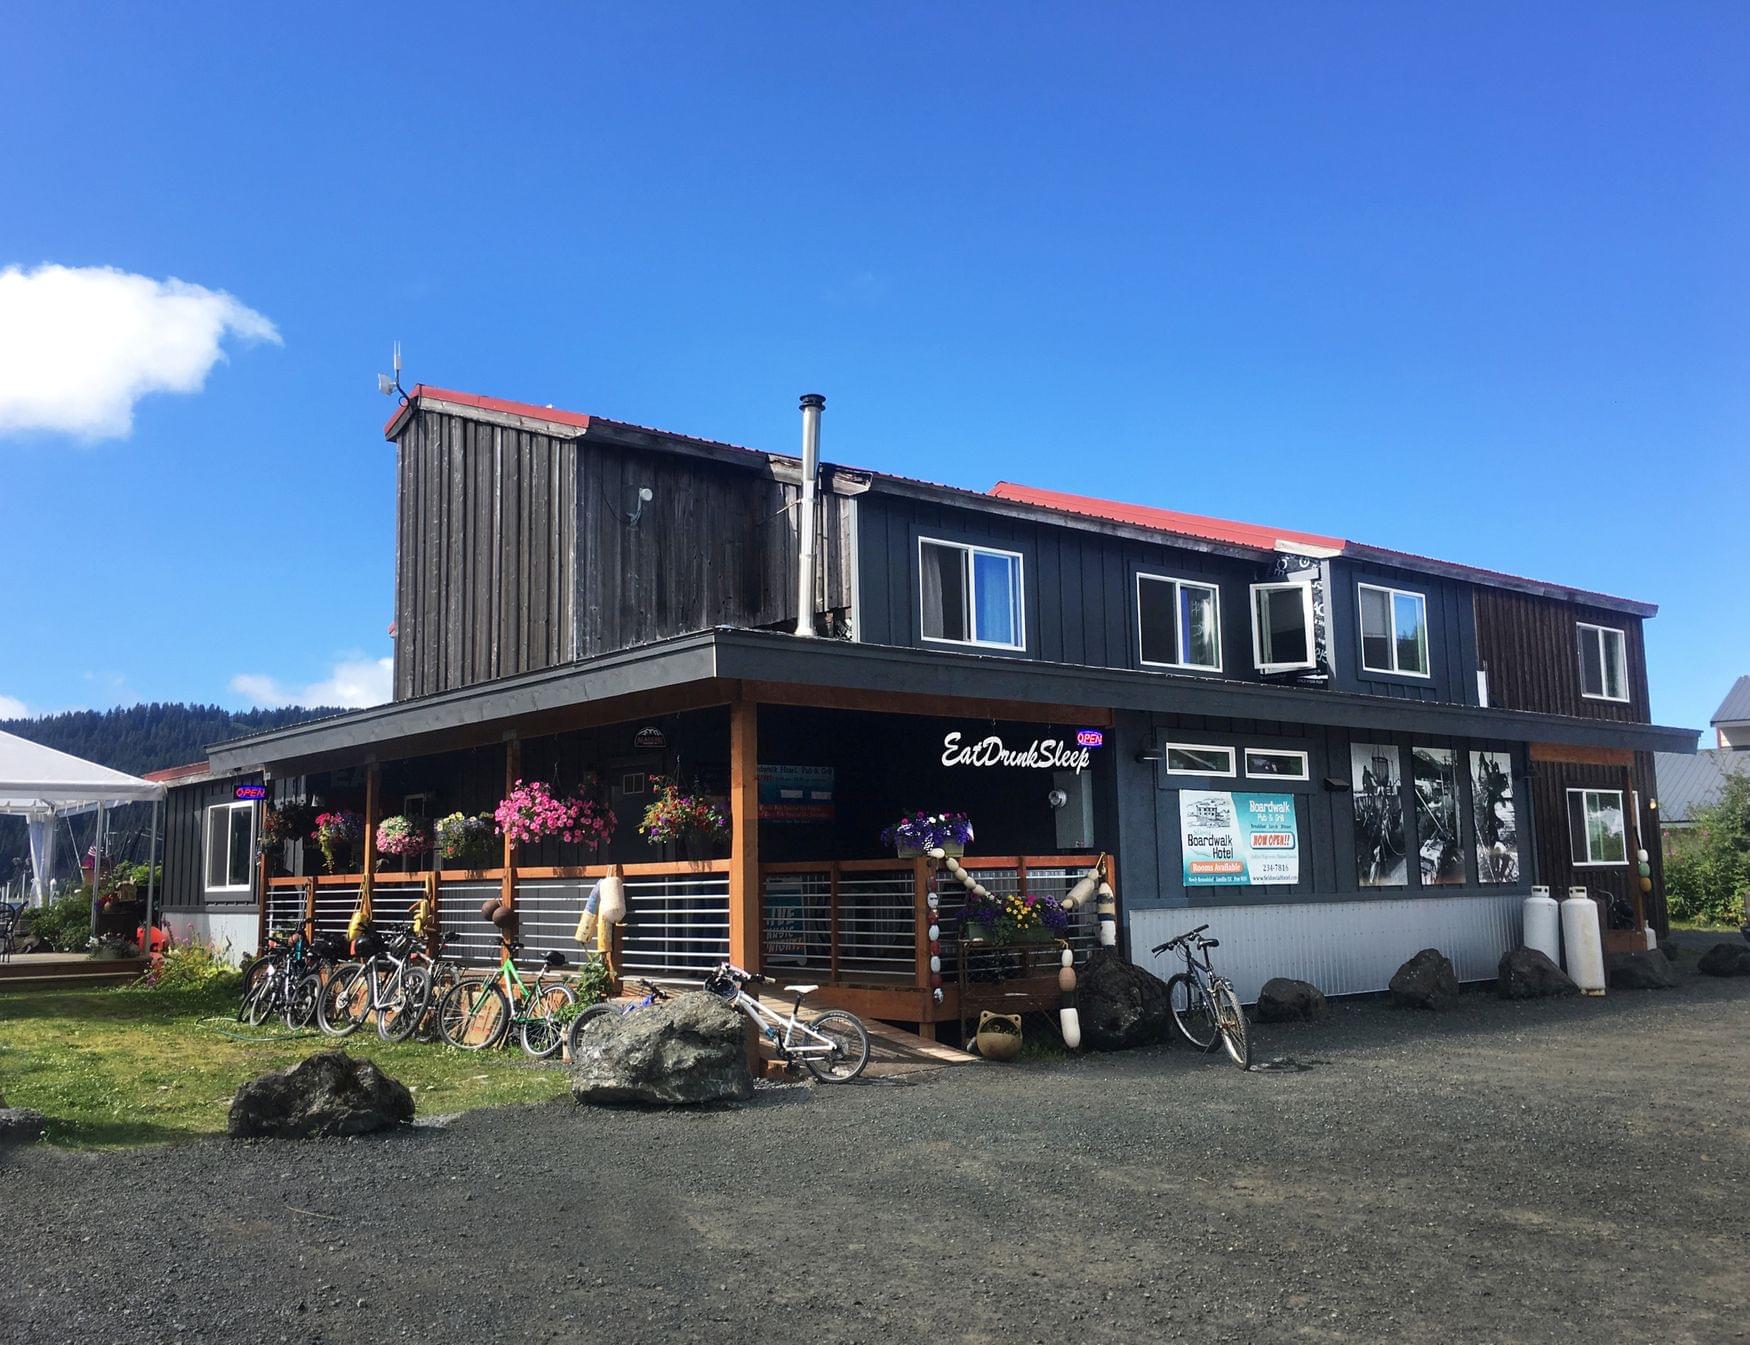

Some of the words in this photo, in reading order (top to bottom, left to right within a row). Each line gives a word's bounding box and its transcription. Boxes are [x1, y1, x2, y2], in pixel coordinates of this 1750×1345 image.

[1077, 733, 1102, 745] OPEN
[236, 787, 265, 797] OPEN
[1249, 800, 1290, 813] Boardwalk
[1258, 813, 1268, 821] Pub
[1187, 834, 1233, 847] Boardwalk
[1253, 834, 1268, 846] NOW
[1269, 834, 1290, 846] OPEN!!
[1212, 847, 1234, 859] Hotel
[1192, 863, 1214, 872] Rooms
[1214, 862, 1241, 872] Available
